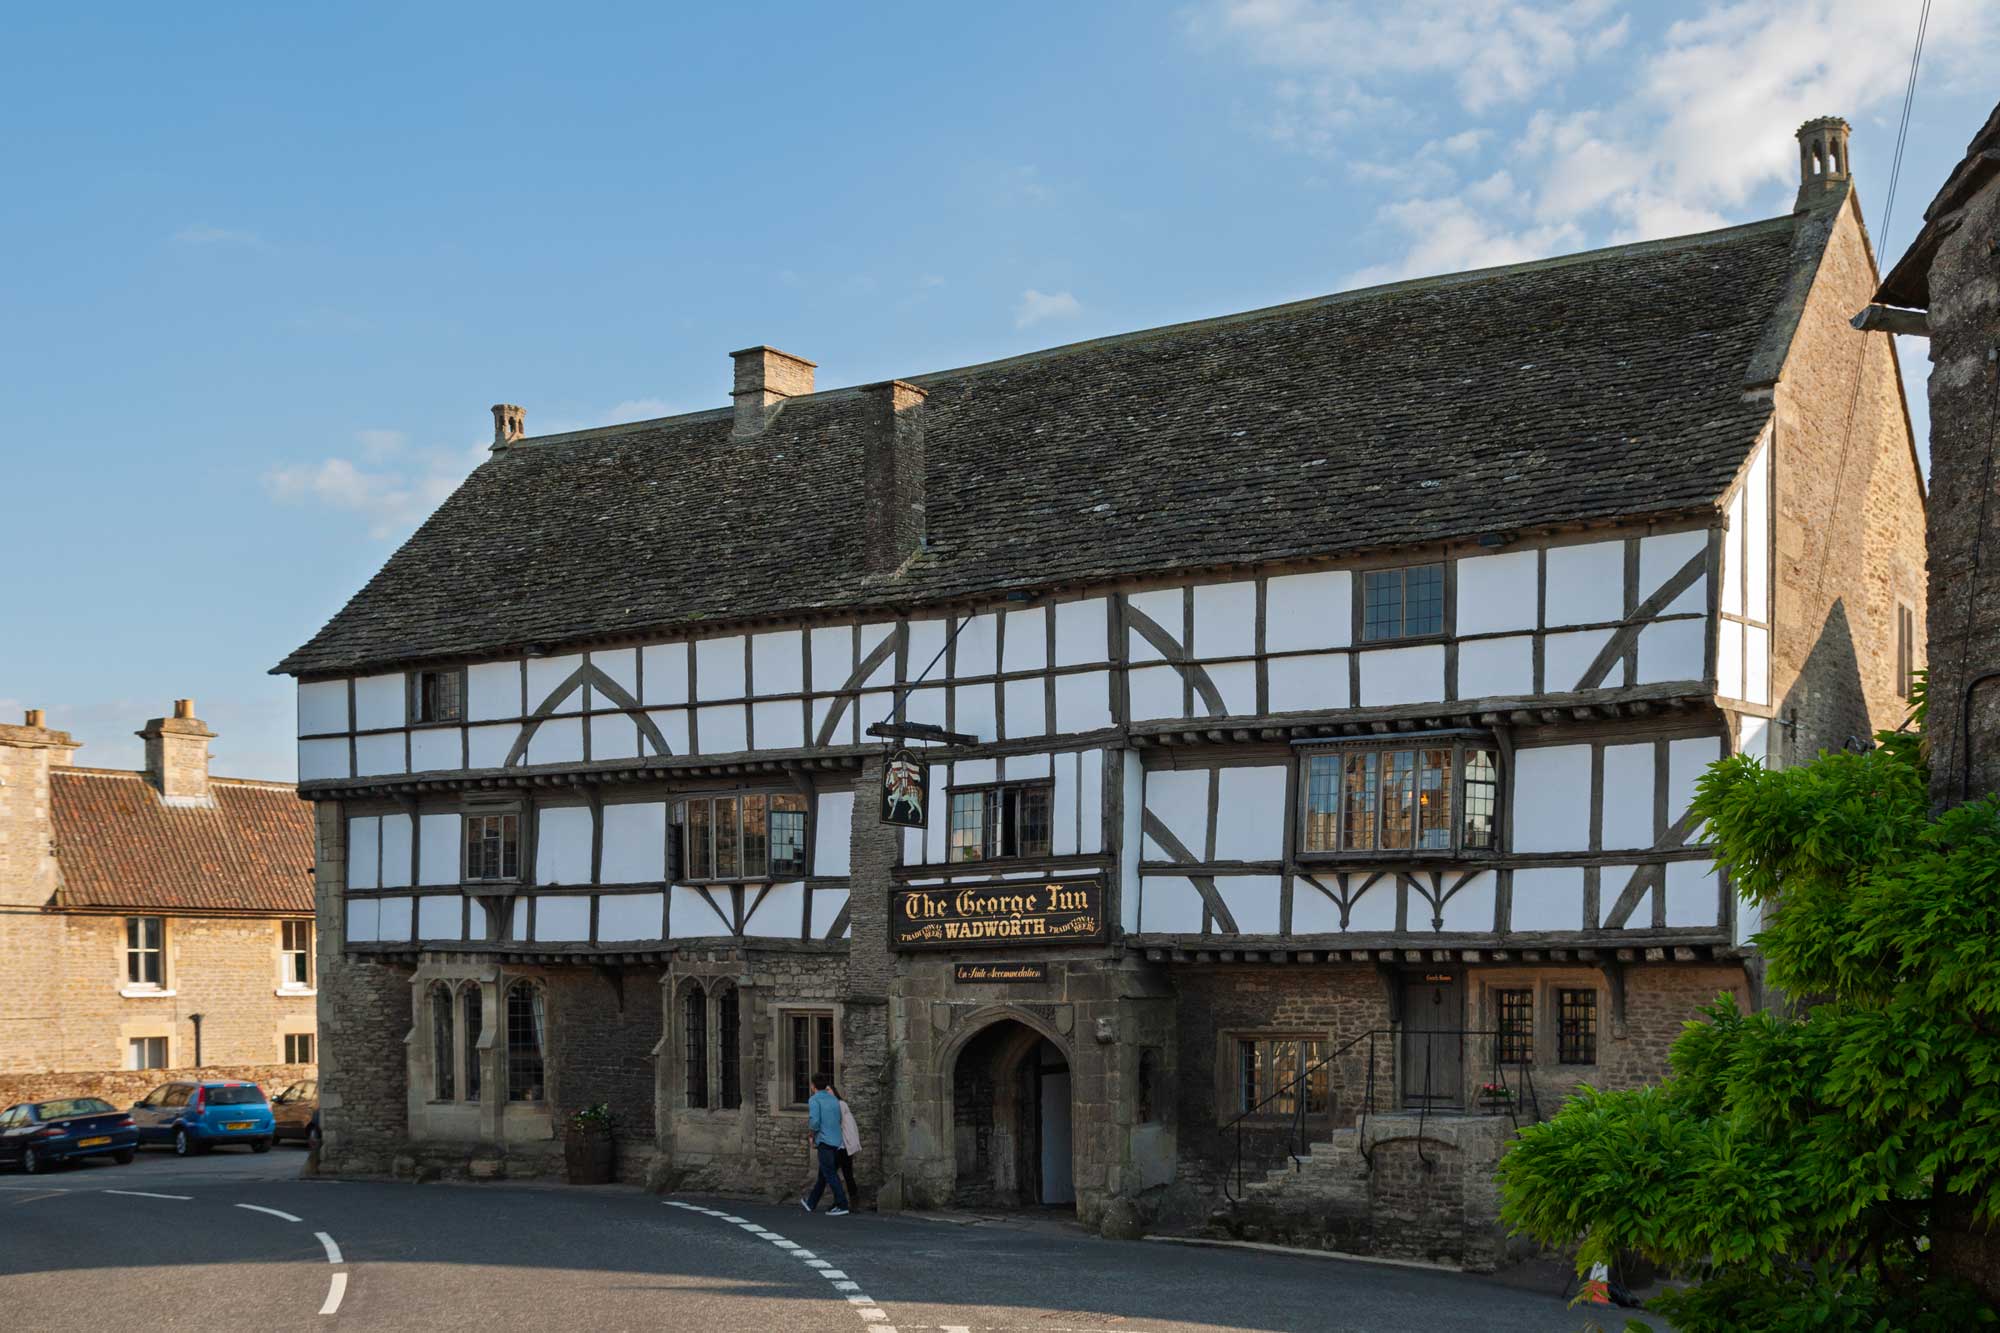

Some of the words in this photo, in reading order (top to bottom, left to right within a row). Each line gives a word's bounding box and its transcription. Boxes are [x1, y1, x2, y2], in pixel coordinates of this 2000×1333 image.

[905, 893, 947, 919] The
[956, 888, 1037, 919] George
[1046, 885, 1089, 911] Inn
[901, 922, 942, 941] TRADITIONAL
[944, 918, 1046, 939] WADWORTH
[1049, 915, 1094, 934] TRADITIONAL
